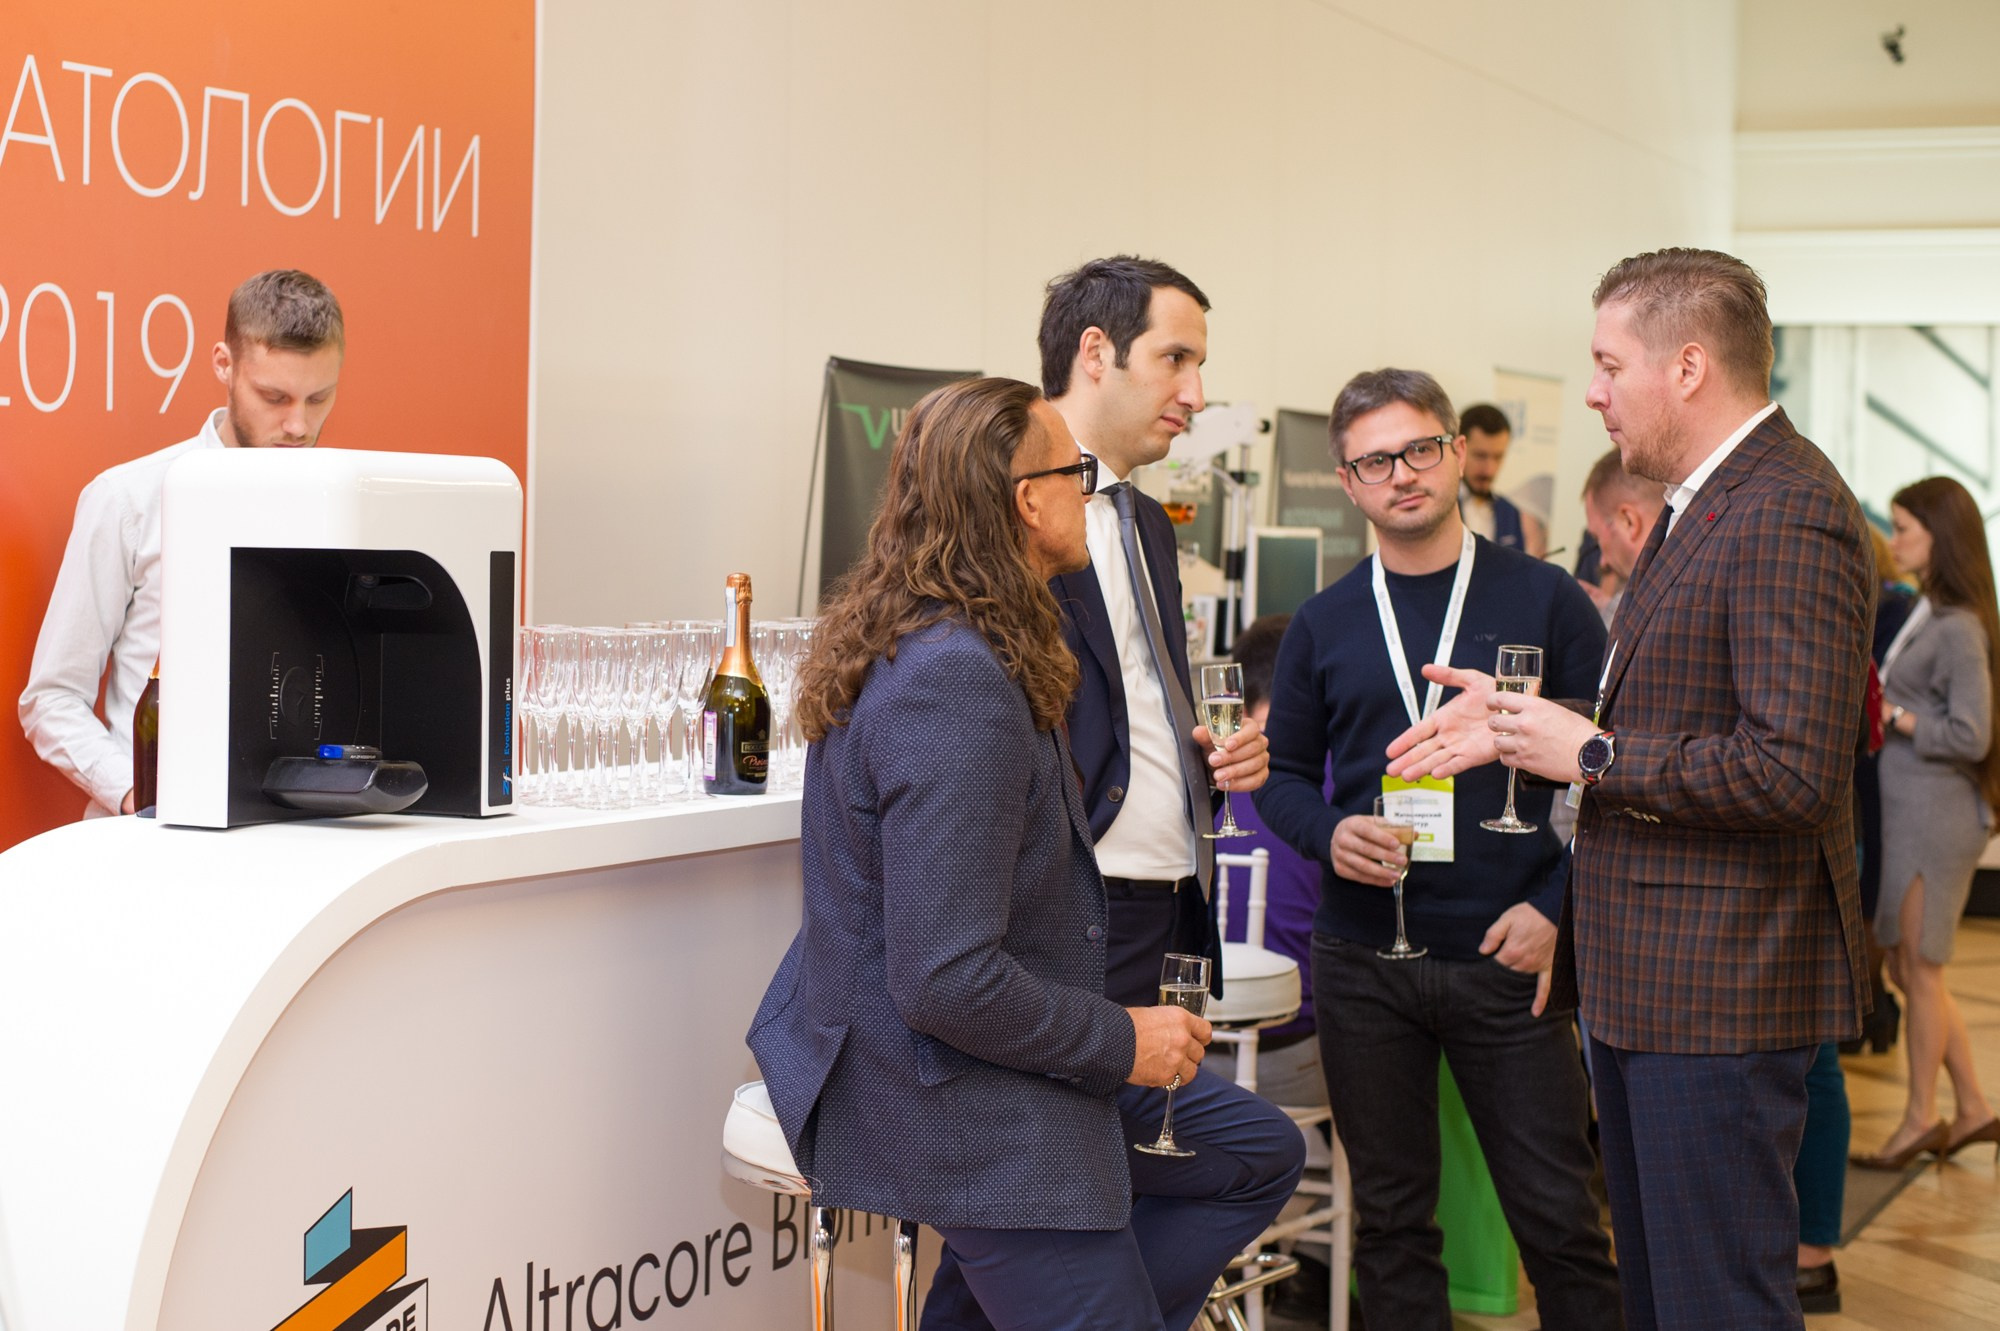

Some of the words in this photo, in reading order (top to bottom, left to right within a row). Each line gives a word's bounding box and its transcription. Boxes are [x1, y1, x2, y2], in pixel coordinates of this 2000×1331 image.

[0, 54, 480, 238] АТОЛОГИИ
[0, 282, 195, 414] 019
[502, 765, 513, 796] Zfx
[503, 703, 511, 756] Evolution
[483, 1221, 753, 1331] Altracore
